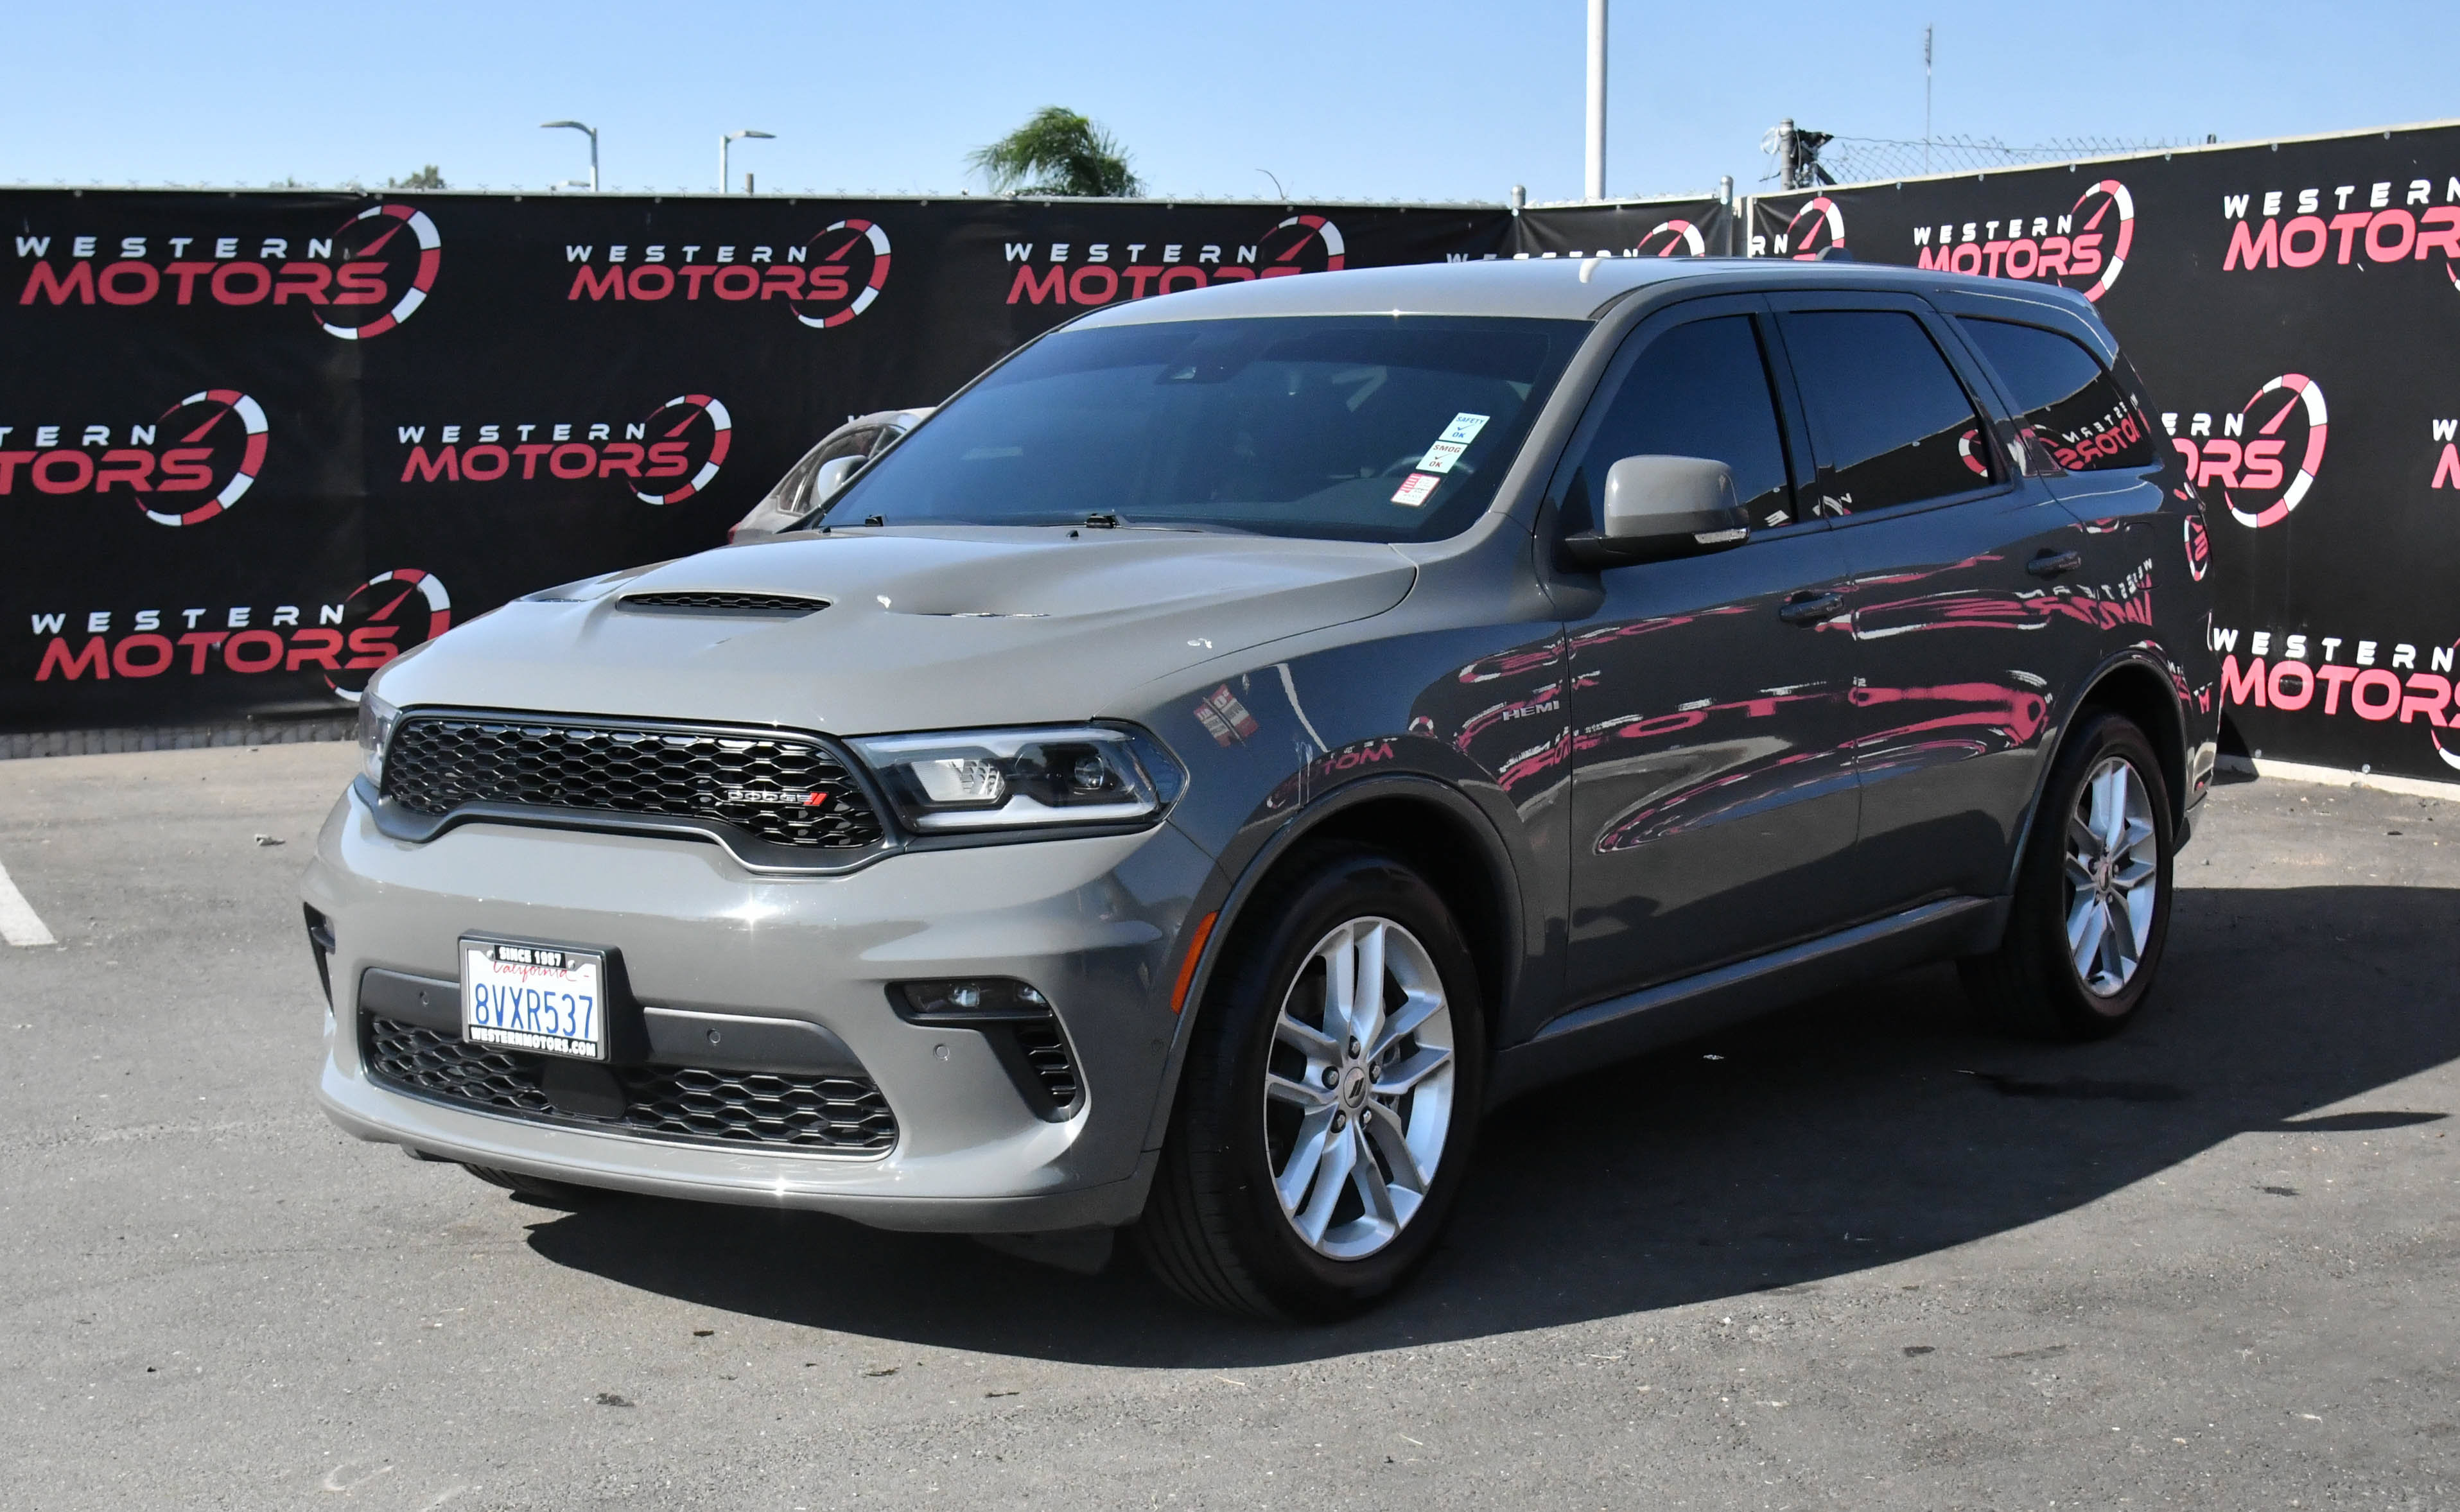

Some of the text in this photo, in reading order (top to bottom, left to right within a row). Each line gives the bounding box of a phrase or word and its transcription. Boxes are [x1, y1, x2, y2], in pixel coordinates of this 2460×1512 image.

[2224, 177, 2460, 219] WESTERN
[1914, 214, 2072, 246] WESTERN
[16, 237, 333, 259] WESTERN
[566, 245, 807, 263] WESTERN
[1005, 243, 1257, 263] WESTERN
[1918, 234, 2103, 279] MOTORS
[19, 261, 388, 306] MOTORS
[568, 265, 850, 300] MOTORS
[1006, 264, 1302, 305] MOTO
[398, 423, 645, 444] WESTERN
[1433, 444, 1461, 453] SMOG
[0, 448, 214, 495] TORS
[400, 441, 689, 482] MOTORS
[31, 604, 344, 634] WESTERN
[35, 626, 399, 682] MOTORS
[2213, 627, 2454, 672] WESTERN
[2222, 655, 2460, 728] MOTOR
[1503, 700, 1560, 720] HEMI
[499, 946, 561, 967] SINCE 1987
[475, 983, 593, 1038] 8VXR537
[471, 1027, 596, 1057] WESTERNMOTORS.COM
